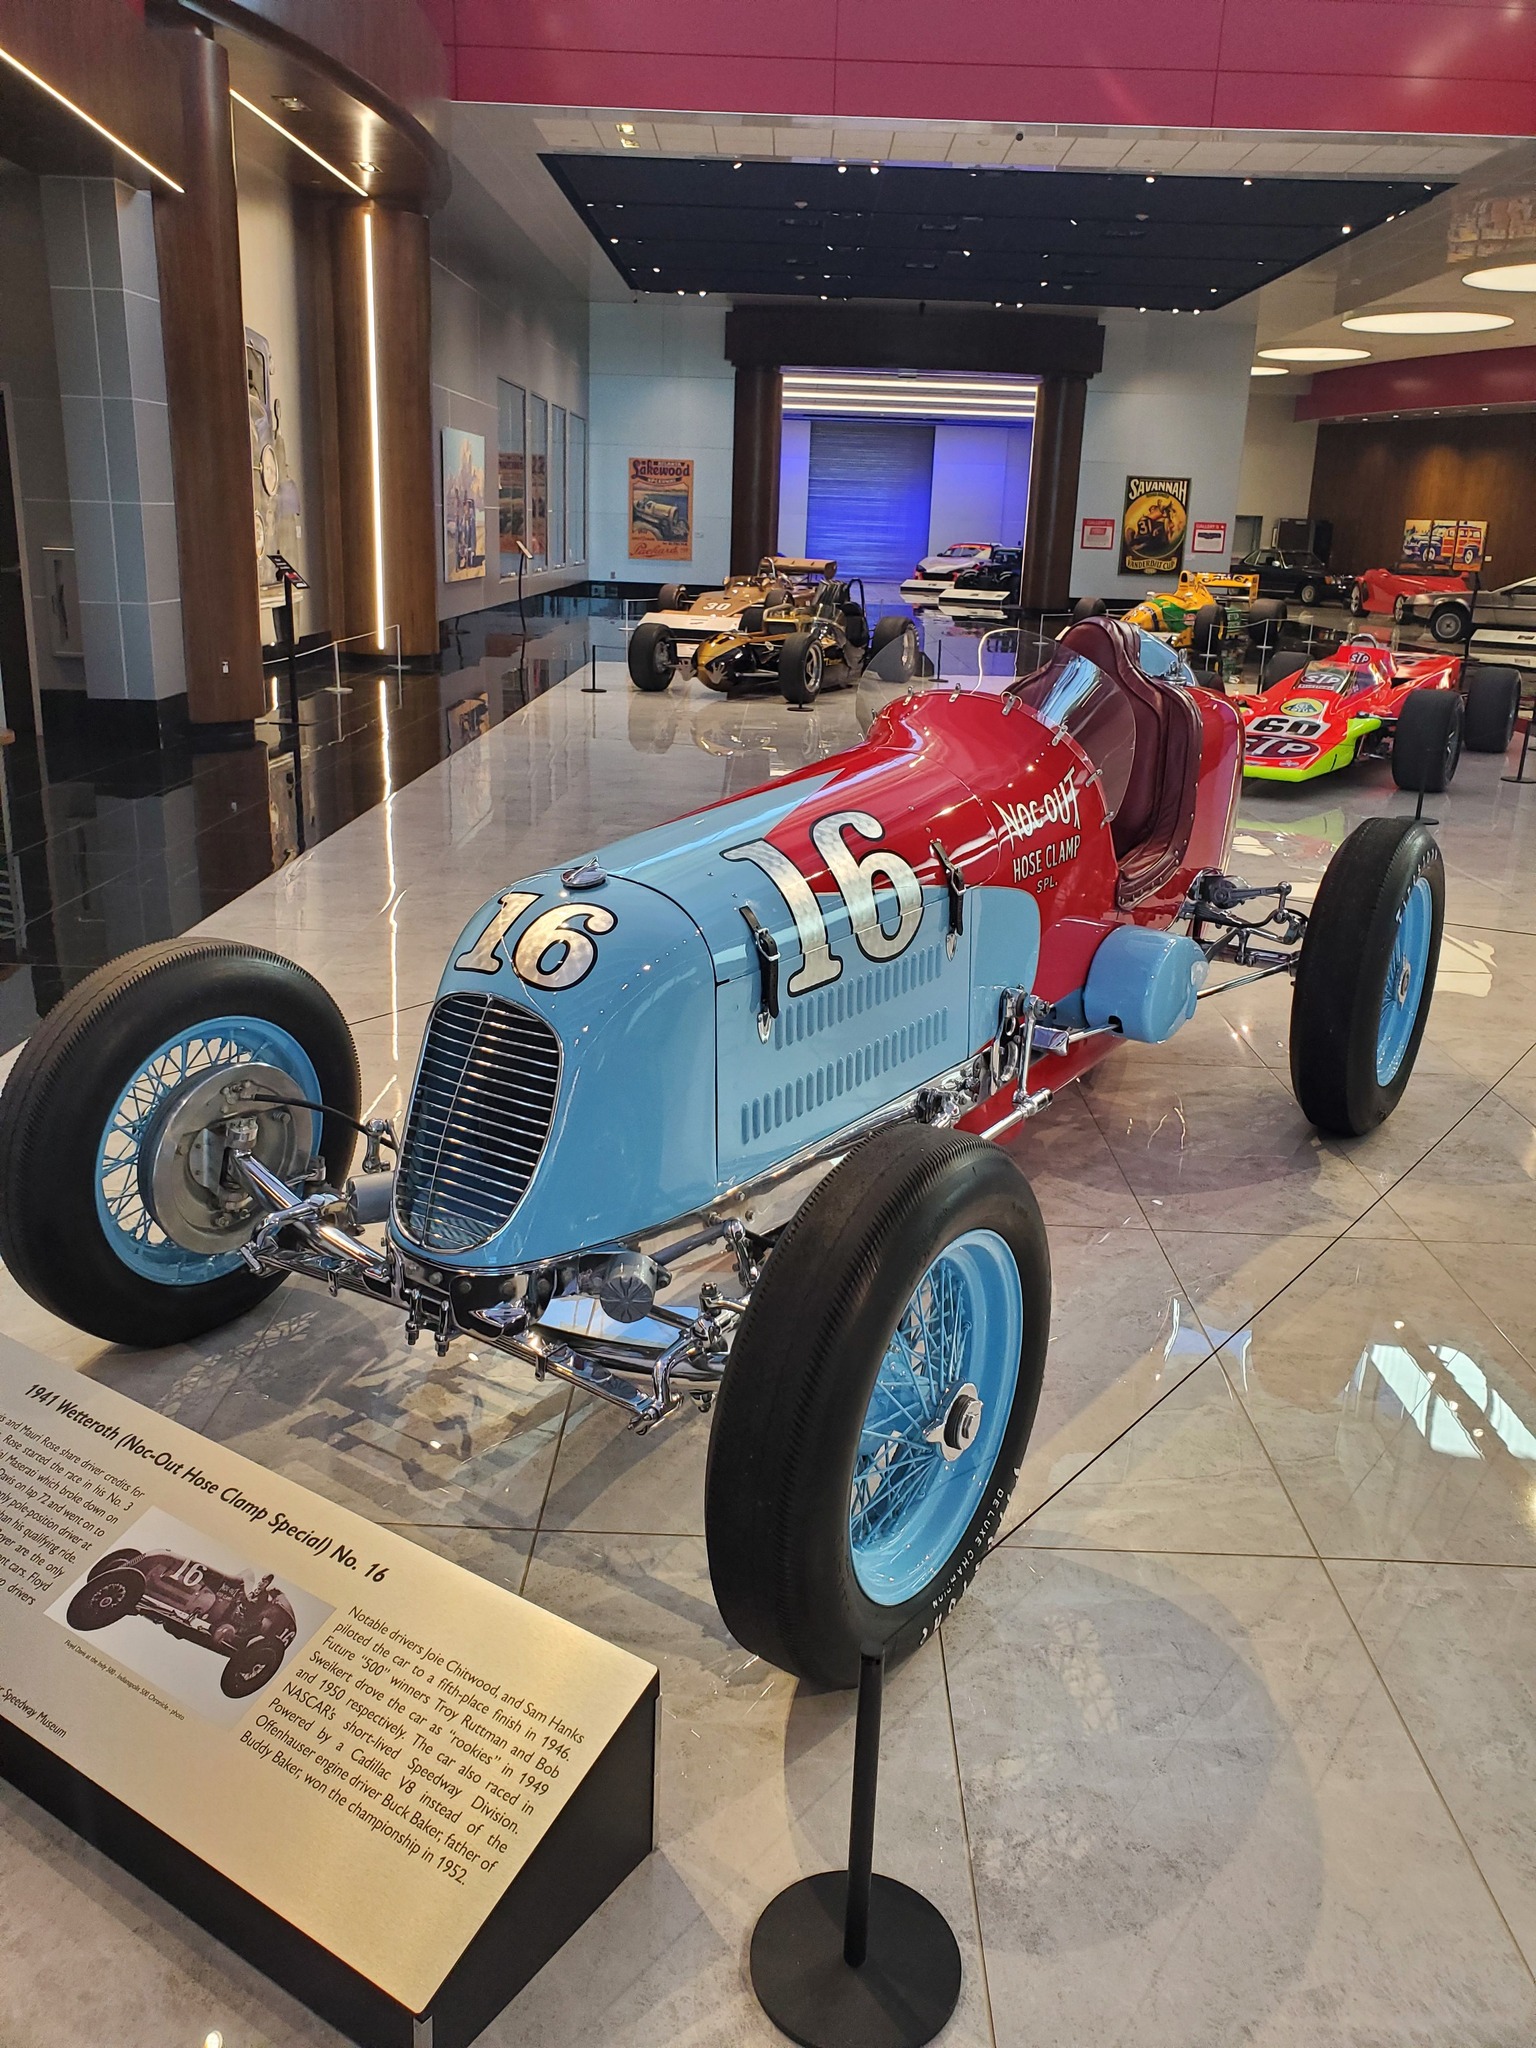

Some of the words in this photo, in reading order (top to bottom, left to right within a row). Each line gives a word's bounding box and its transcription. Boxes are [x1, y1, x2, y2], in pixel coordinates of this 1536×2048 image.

[631, 459, 690, 479] Lakewood
[1128, 478, 1188, 506] SAVANNAH
[1162, 560, 1175, 570] CUP
[702, 602, 732, 611] 30
[1306, 673, 1341, 684] STP
[1350, 651, 1369, 663] STP
[1253, 717, 1321, 737] 60
[1013, 849, 1043, 883] HOSE
[1045, 835, 1081, 869] CLAMP
[1037, 876, 1058, 893] SPL.
[720, 809, 924, 998] 16
[453, 890, 618, 991] 16
[2, 1433, 23, 1450] Rose
[21, 1447, 53, 1466] started
[49, 1461, 65, 1474] the
[63, 1470, 83, 1484] race
[81, 1478, 93, 1490] in
[91, 1483, 107, 1498] his
[105, 1491, 122, 1507] No.
[122, 1501, 134, 1511] 3
[4, 1418, 24, 1430] and
[18, 1424, 44, 1442] Mauri
[39, 1436, 61, 1453] Rose
[58, 1448, 81, 1464] share
[80, 1459, 105, 1476] driver
[103, 1473, 132, 1492] credits
[129, 1485, 145, 1499] for
[24, 1384, 61, 1406] 1941
[55, 1398, 120, 1441] Wetteroth
[114, 1433, 184, 1475] (Noc-Out
[180, 1466, 219, 1494] Hose
[220, 1487, 268, 1522] Clamp
[267, 1512, 333, 1556] Special)
[329, 1544, 357, 1570] No.
[364, 1563, 390, 1583] 16
[4, 1454, 40, 1478] Maserati
[36, 1473, 61, 1491] which
[58, 1484, 83, 1504] broke
[82, 1499, 106, 1518] down
[105, 1514, 119, 1525] on
[13, 1481, 27, 1492] on
[24, 1485, 38, 1499] lap
[36, 1491, 52, 1505] 72
[46, 1500, 67, 1513] and
[62, 1508, 84, 1525] went
[81, 1520, 95, 1532] on
[92, 1527, 105, 1537] to
[6, 1499, 60, 1532] pole-position
[57, 1526, 84, 1545] driver
[80, 1541, 93, 1551] at
[10, 1517, 25, 1532] his
[22, 1528, 60, 1555] qualifying
[57, 1548, 76, 1564] ride.
[7, 1562, 27, 1579] cars.
[26, 1571, 54, 1592] Floyd
[14, 1544, 30, 1557] are
[29, 1552, 46, 1566] the
[45, 1563, 65, 1580] only
[169, 1558, 208, 1587] 16
[6, 1582, 36, 1606] drivers
[332, 1623, 373, 1647] piloted
[371, 1642, 390, 1658] the
[391, 1655, 411, 1668] car
[411, 1664, 425, 1678] to
[426, 1674, 435, 1684] a
[436, 1677, 490, 1715] fifth-place
[491, 1708, 522, 1733] finish
[524, 1726, 537, 1742] in
[541, 1735, 571, 1762] 1946.
[347, 1605, 389, 1635] Notable
[388, 1629, 424, 1655] drivers
[419, 1647, 445, 1666] Joie
[445, 1659, 501, 1699] Chitwood,
[500, 1692, 526, 1710] and
[522, 1702, 547, 1723] Sam
[547, 1715, 585, 1744] Hanks
[1, 1688, 38, 1719] Speedway
[35, 1711, 67, 1738] Museum
[169, 1709, 185, 1721] photo
[309, 1650, 353, 1683] Sweikert
[354, 1678, 385, 1701] drove
[386, 1697, 406, 1714] the
[408, 1711, 428, 1725] car
[428, 1723, 443, 1736] as
[500, 1762, 514, 1778] in
[518, 1772, 549, 1796] 1949
[322, 1634, 356, 1661] Future
[389, 1675, 431, 1704] winners
[434, 1697, 460, 1722] Troy
[460, 1713, 508, 1749] Ruttman
[509, 1745, 536, 1764] and
[534, 1756, 560, 1779] Bob
[295, 1668, 319, 1684] and
[318, 1679, 346, 1701] 1950
[345, 1698, 407, 1740] respectively.
[412, 1732, 434, 1755] The
[436, 1752, 457, 1767] car
[457, 1764, 482, 1784] also
[484, 1781, 521, 1806] raced
[520, 1799, 534, 1816] in
[255, 1714, 316, 1758] Offenhauser
[314, 1754, 349, 1781] engine
[348, 1774, 383, 1800] driver
[380, 1792, 411, 1820] Buck
[408, 1810, 444, 1843] Baker,
[443, 1833, 481, 1863] father
[480, 1859, 499, 1873] of
[267, 1697, 316, 1731] Powered
[316, 1726, 333, 1745] by
[335, 1741, 344, 1752] a
[350, 1748, 392, 1781] Cadillac
[398, 1775, 417, 1794] V8
[418, 1790, 463, 1824] instead
[466, 1823, 485, 1836] of
[486, 1833, 508, 1854] the
[342, 1720, 403, 1760] short-lived
[407, 1757, 463, 1800] Speedway
[470, 1795, 518, 1835] Division.
[239, 1729, 273, 1759] Buddy
[271, 1749, 303, 1779] Baker,
[303, 1772, 328, 1794] won
[327, 1788, 347, 1806] the
[347, 1801, 421, 1856] championship
[420, 1846, 434, 1863] in
[436, 1856, 467, 1885] 1952.
